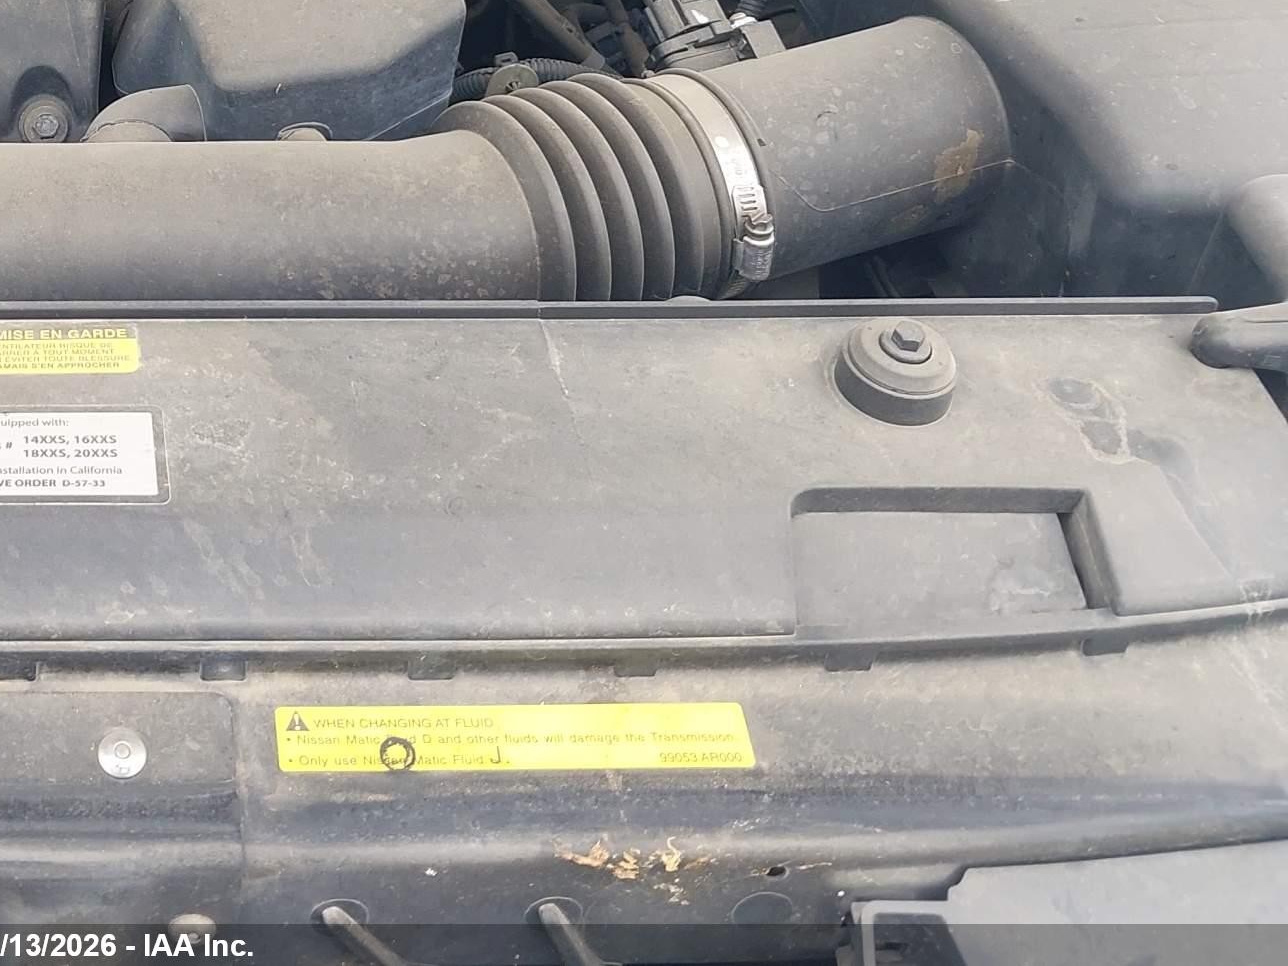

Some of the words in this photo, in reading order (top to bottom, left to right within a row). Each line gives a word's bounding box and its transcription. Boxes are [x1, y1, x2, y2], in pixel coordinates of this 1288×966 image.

[40, 329, 62, 339] EN
[68, 328, 128, 339] GARDE
[42, 417, 69, 427] with:
[24, 435, 69, 445] 14XXS,
[74, 435, 117, 444] 16XXS
[24, 449, 70, 459] 18XXS,
[74, 449, 118, 458] 20XXS
[70, 465, 123, 475] California
[14, 479, 57, 488] ORDER
[62, 479, 106, 488] D-57-33
[313, 718, 355, 729] WHEN
[359, 718, 432, 729] CHANGING
[435, 718, 450, 729] AT
[455, 717, 494, 729] FLUID
[297, 735, 340, 745] Nissan
[346, 734, 380, 745] Matic
[438, 734, 461, 744] and
[466, 734, 499, 744] other
[504, 733, 538, 744] fluids
[545, 733, 563, 743] will
[569, 733, 620, 745] damage
[625, 732, 645, 743] the
[298, 755, 328, 767] Only
[334, 756, 357, 765] use
[453, 754, 484, 764] Fluid
